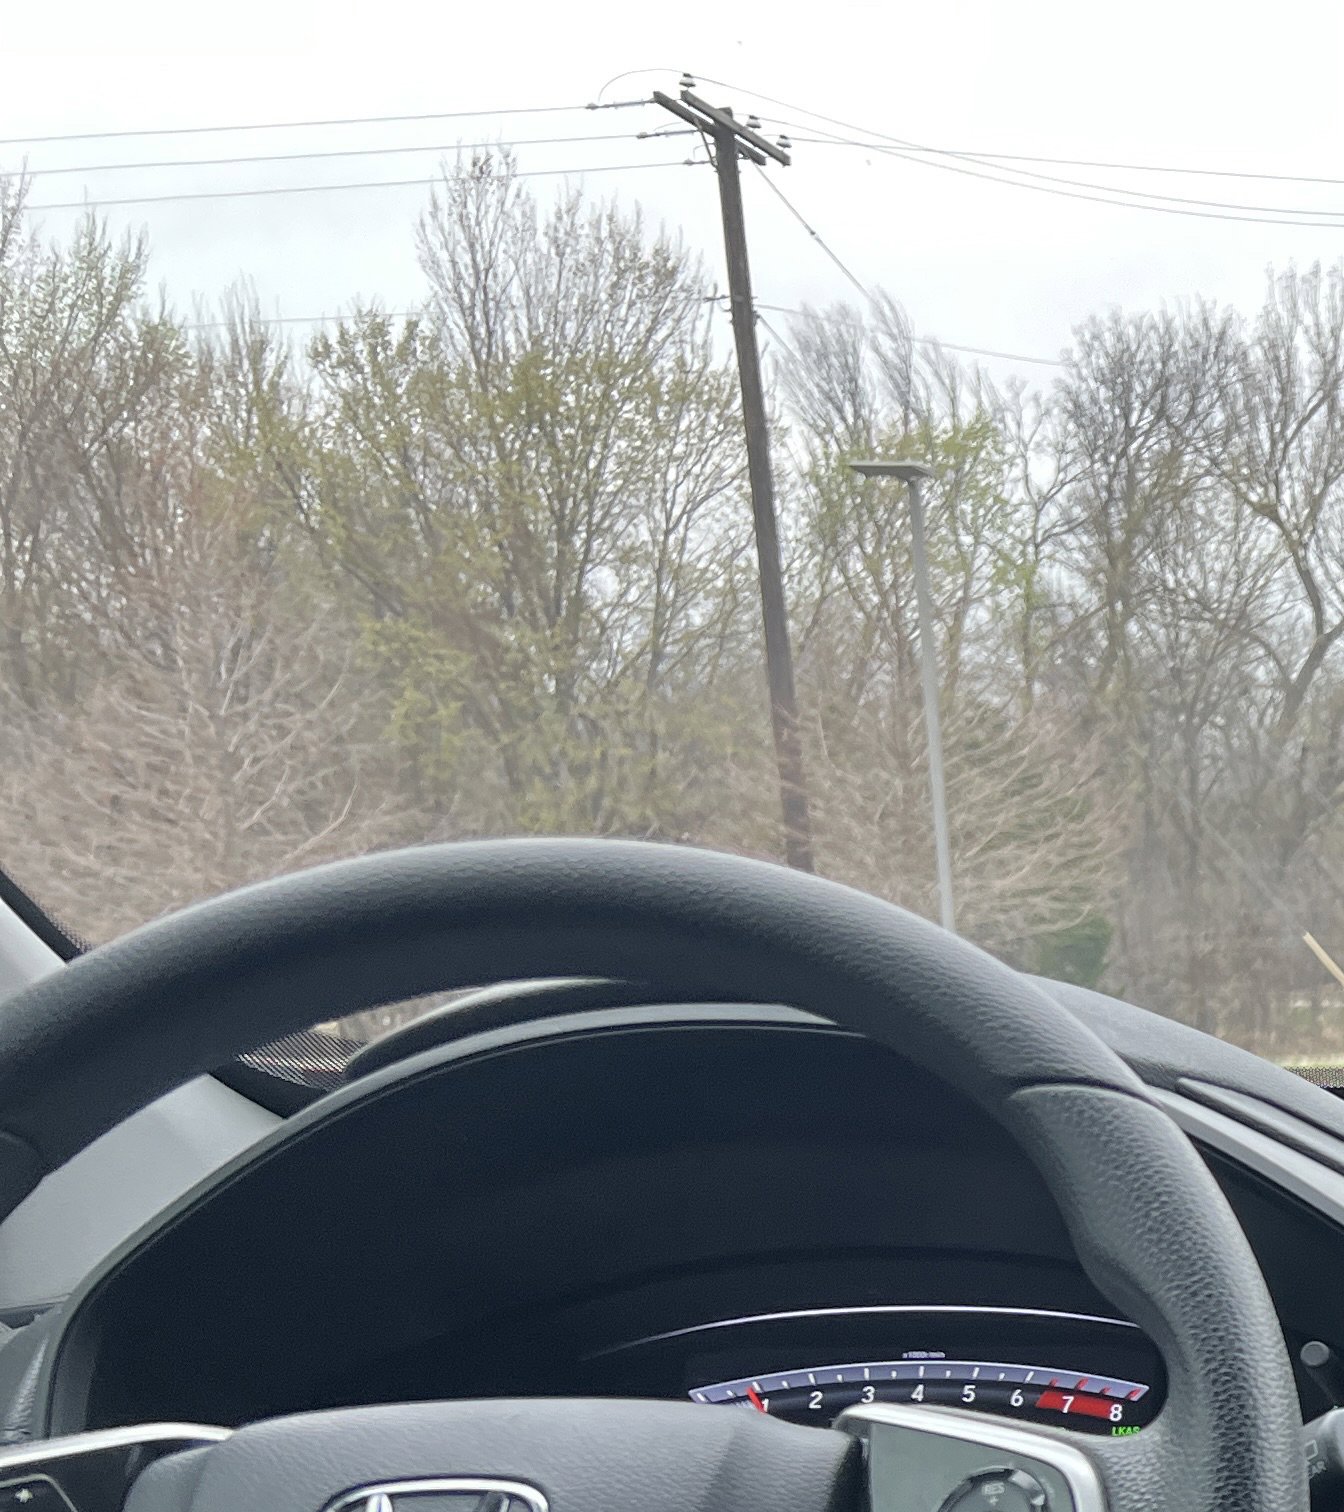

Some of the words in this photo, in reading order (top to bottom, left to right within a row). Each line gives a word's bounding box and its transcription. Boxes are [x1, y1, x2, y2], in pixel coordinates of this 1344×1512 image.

[808, 1390, 824, 1409] 2
[861, 1385, 875, 1404] 3
[911, 1384, 925, 1402] 4
[962, 1384, 976, 1402] 5
[1010, 1389, 1024, 1407] 6
[1062, 1395, 1075, 1414] 7
[1109, 1404, 1123, 1422] 8
[1111, 1425, 1141, 1437] LKAS
